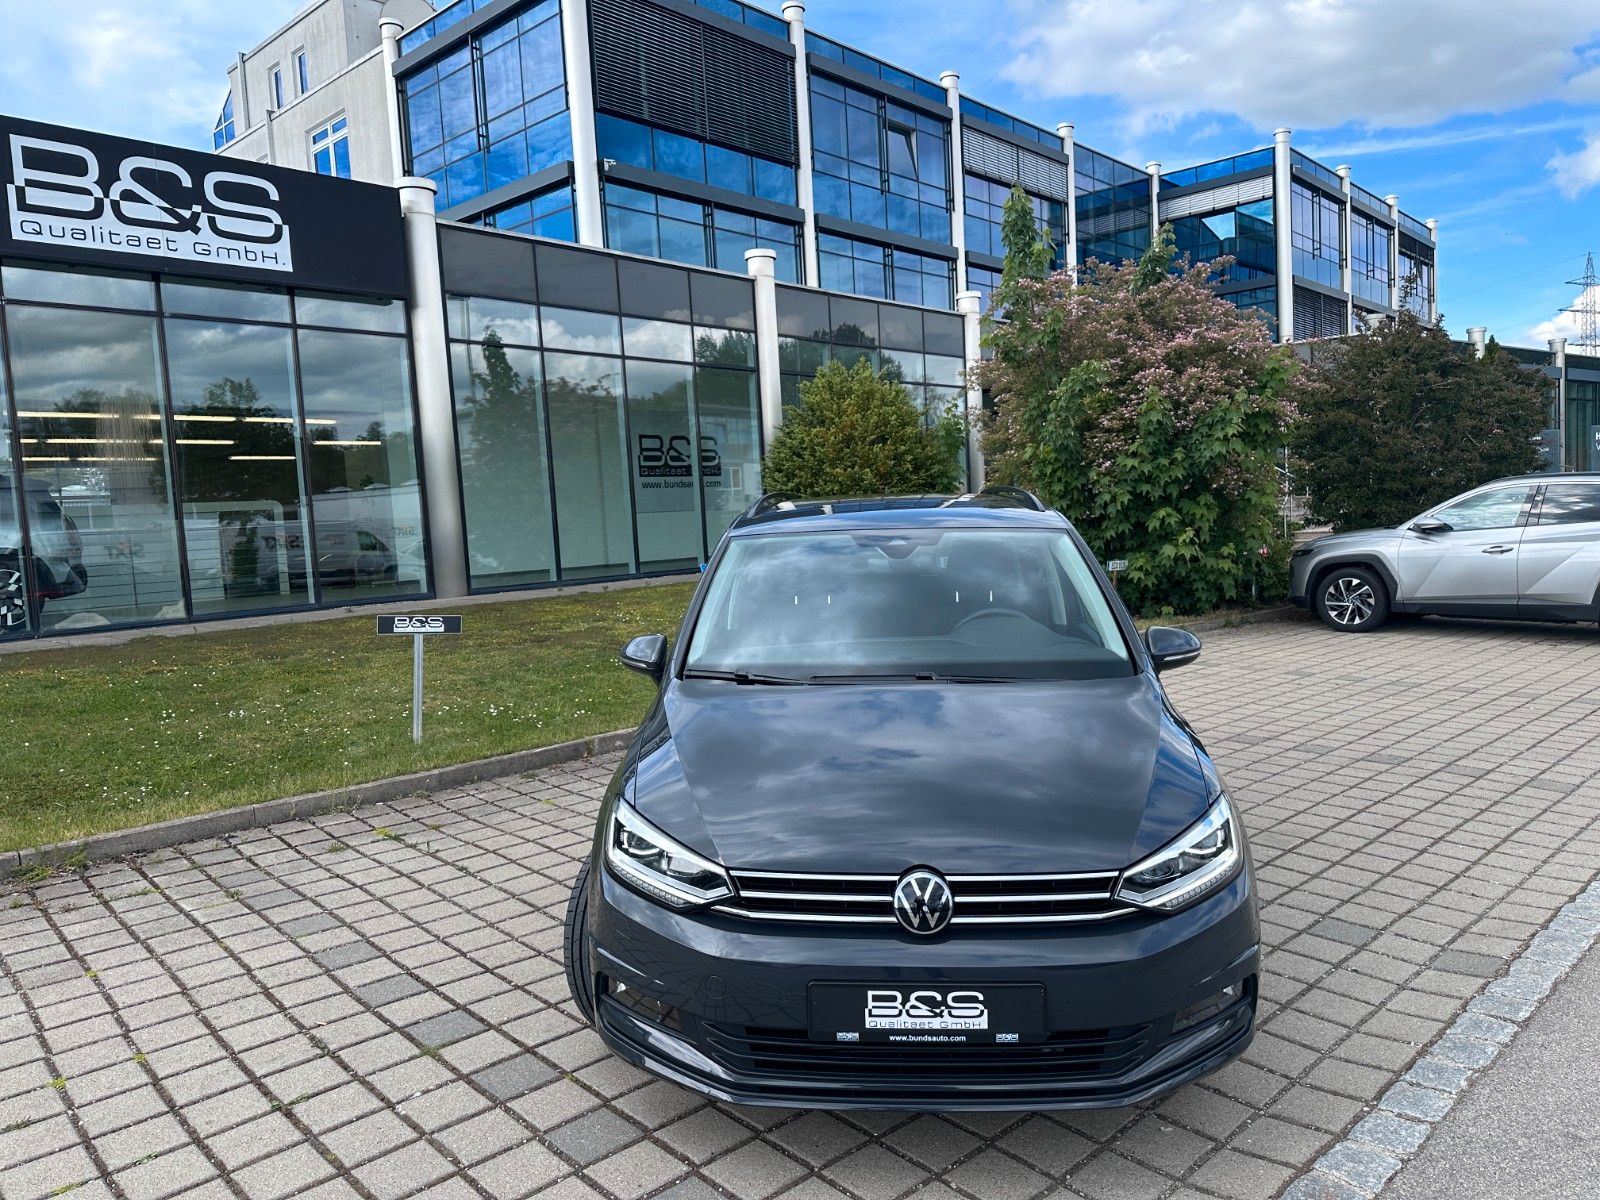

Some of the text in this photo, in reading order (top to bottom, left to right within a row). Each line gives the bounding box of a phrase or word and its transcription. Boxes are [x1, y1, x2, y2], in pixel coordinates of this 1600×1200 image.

[8, 133, 283, 245] B&S
[19, 219, 286, 266] Qualitaet GmbH.
[638, 434, 720, 466] B&S
[641, 467, 687, 475] Qualitaet
[641, 480, 721, 489] www.bundsa.com
[394, 617, 444, 628] B&S
[866, 990, 986, 1018] B&S
[868, 1020, 934, 1028] Qualitaet
[889, 1034, 966, 1042] www.bundsauto.com
